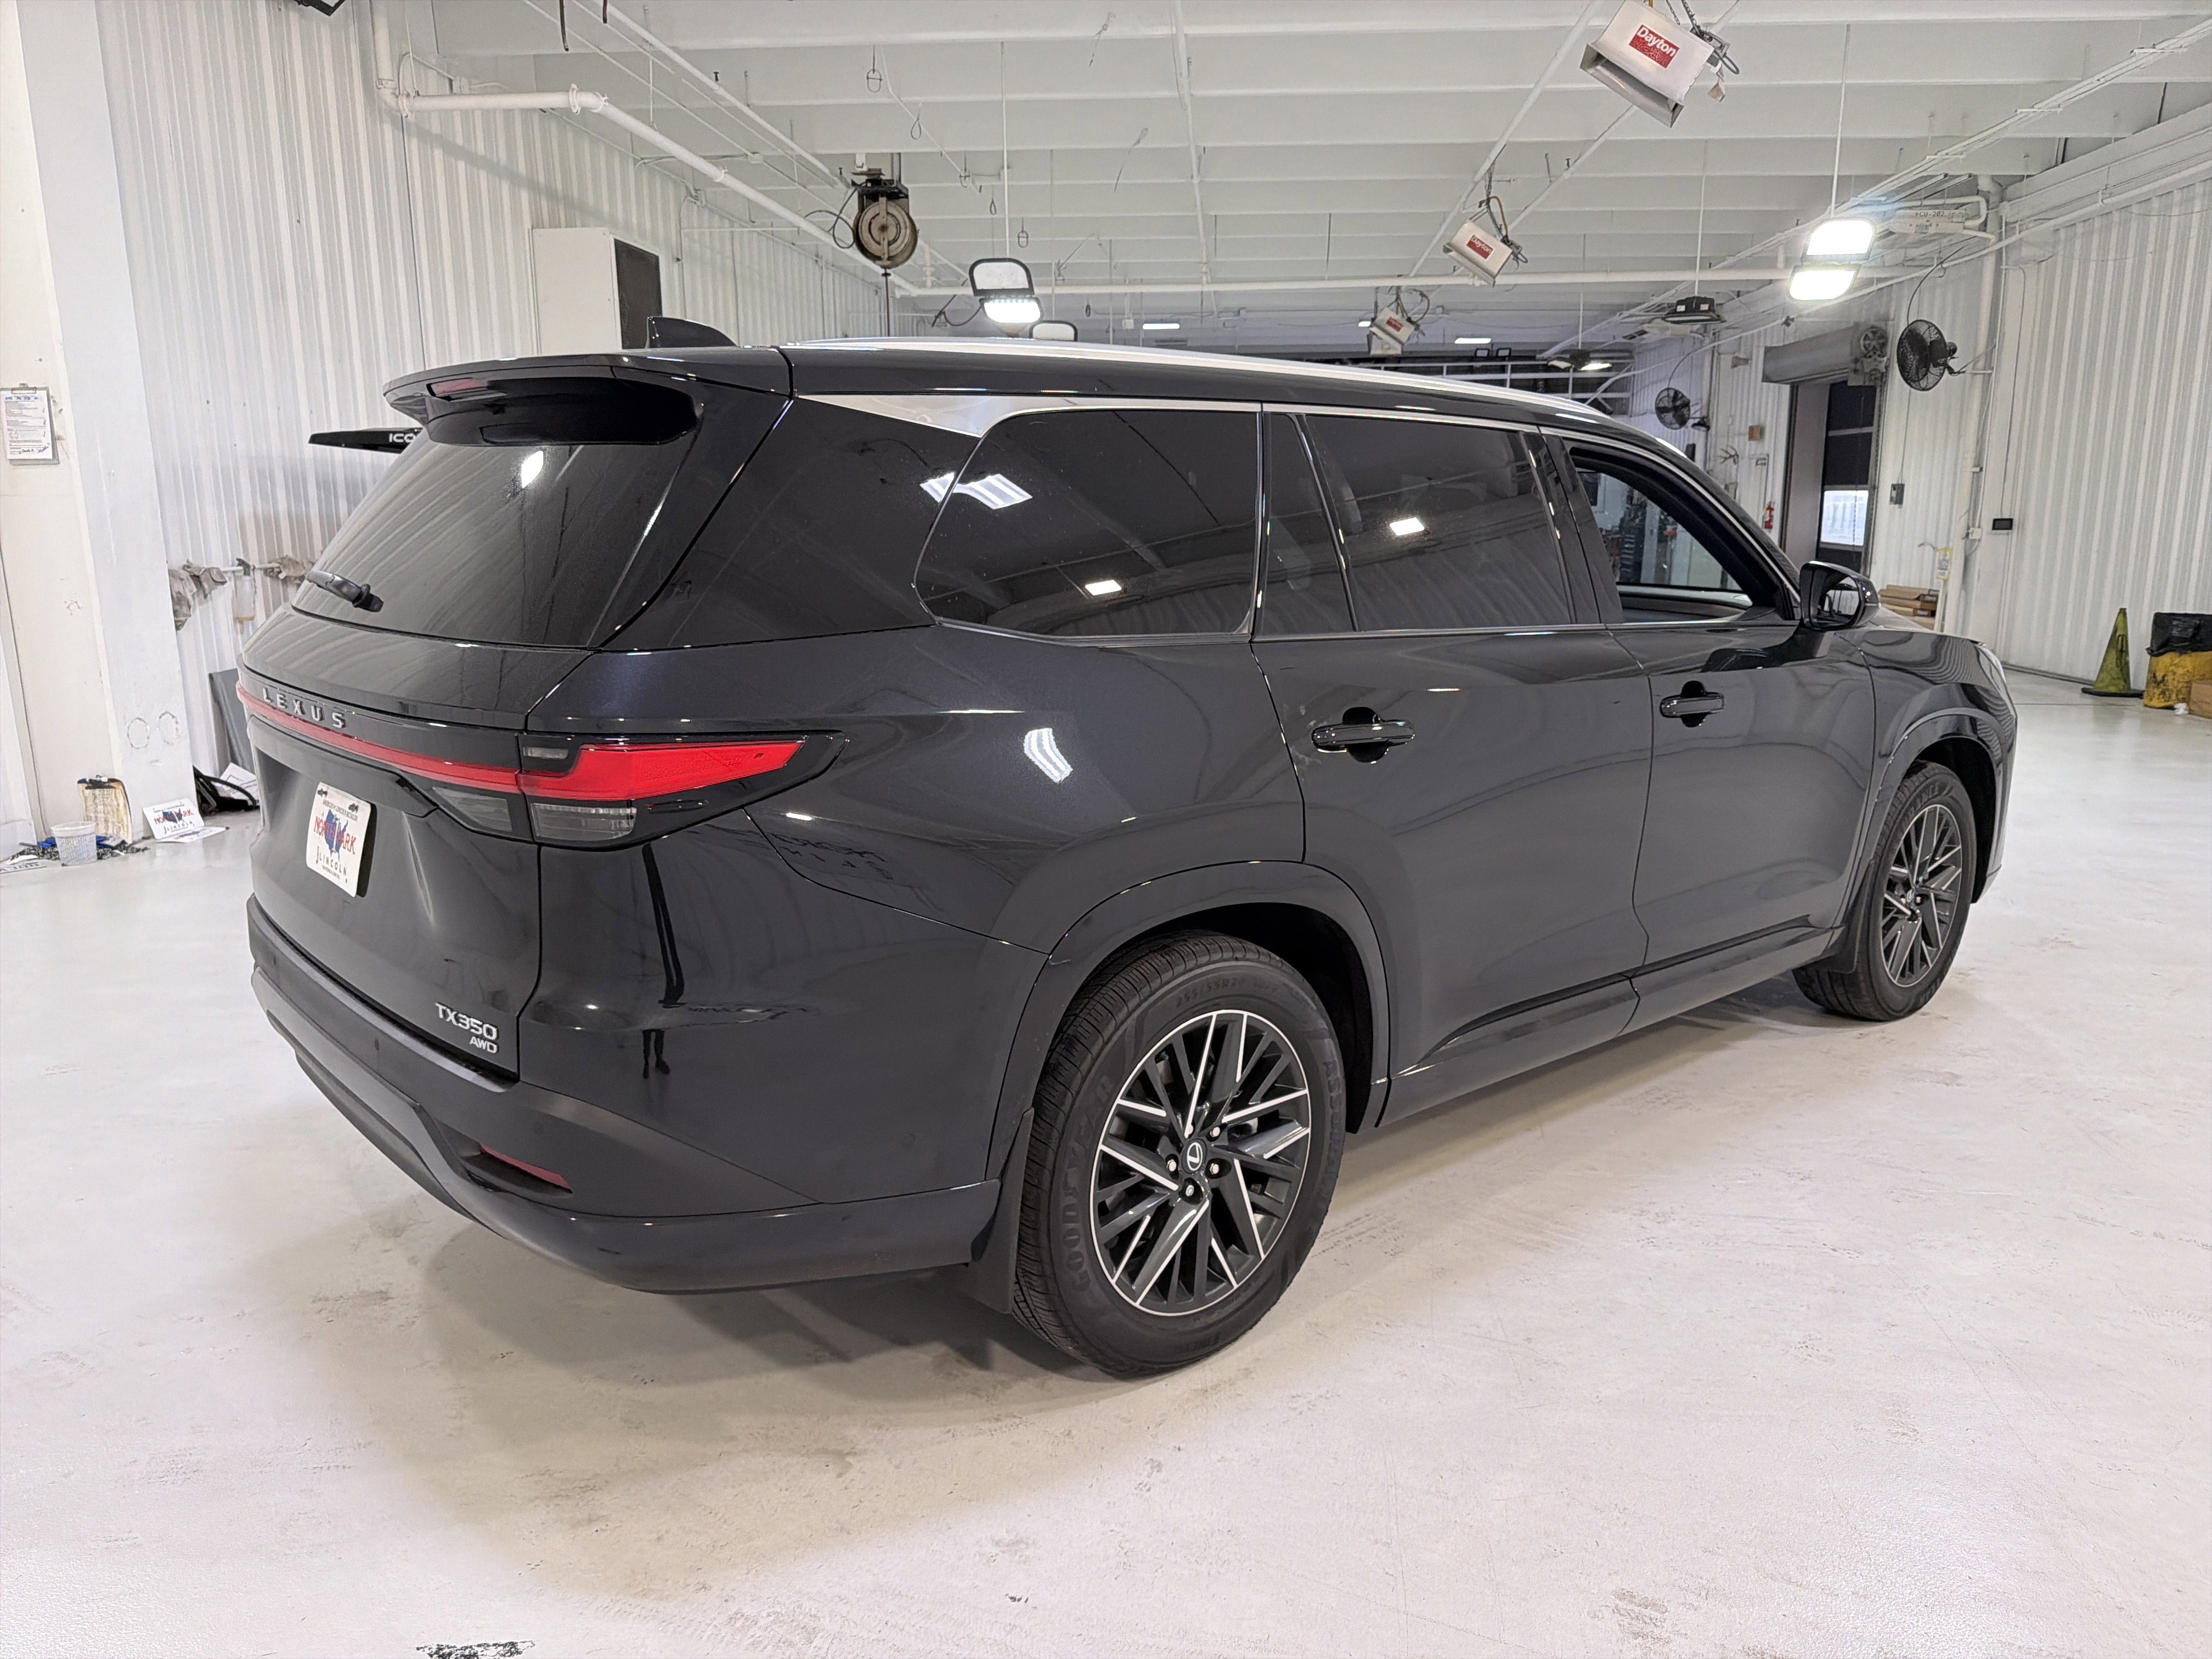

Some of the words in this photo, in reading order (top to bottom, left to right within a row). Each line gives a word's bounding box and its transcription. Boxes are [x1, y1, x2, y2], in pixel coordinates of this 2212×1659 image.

[1636, 26, 1677, 57] Dayton
[388, 433, 415, 443] ICO
[262, 687, 347, 729] LEXUS
[336, 828, 357, 855] PARK
[319, 852, 347, 876] LINCOLN
[435, 1002, 498, 1040] TX350
[469, 1036, 498, 1053] AWD
